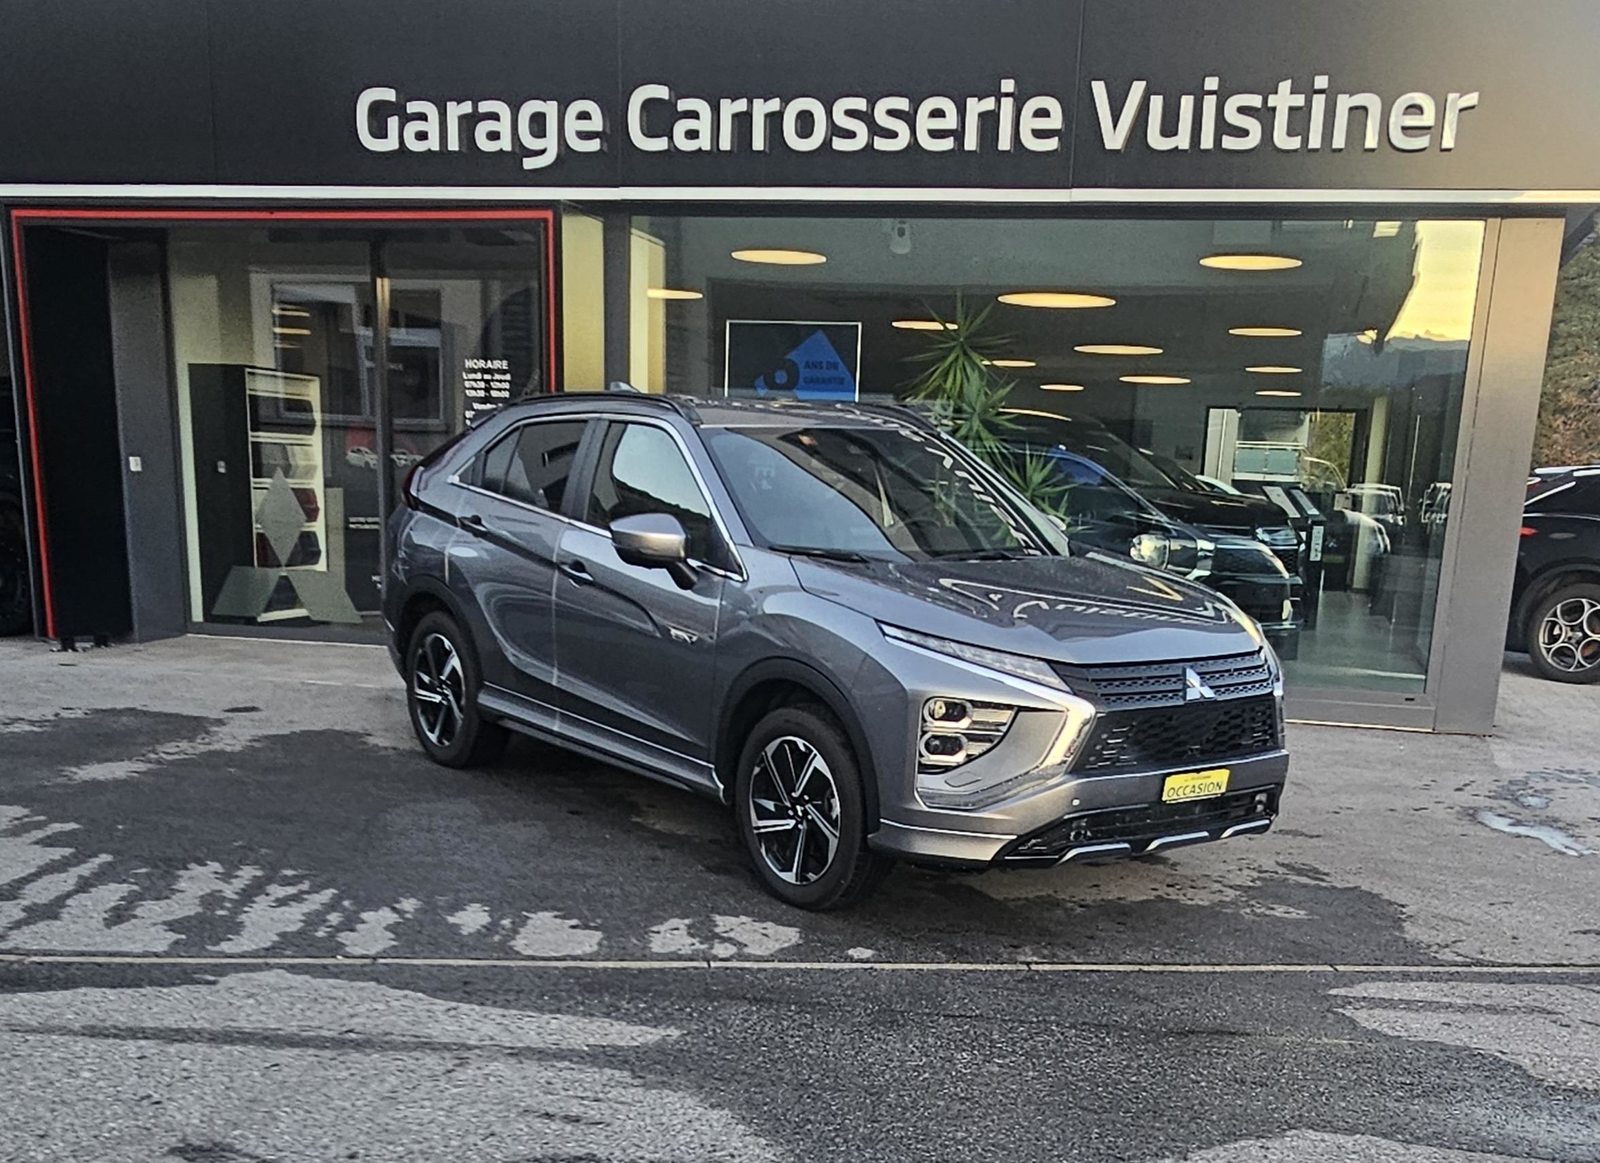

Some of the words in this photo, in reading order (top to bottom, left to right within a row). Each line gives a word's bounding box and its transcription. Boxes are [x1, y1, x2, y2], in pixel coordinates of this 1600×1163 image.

[356, 86, 604, 170] Garage
[627, 78, 1064, 152] Carrosserie
[1091, 75, 1480, 151] Vuistiner
[465, 358, 509, 370] HORAIRE
[803, 360, 824, 370] ANS
[1166, 781, 1223, 798] OCCASION
